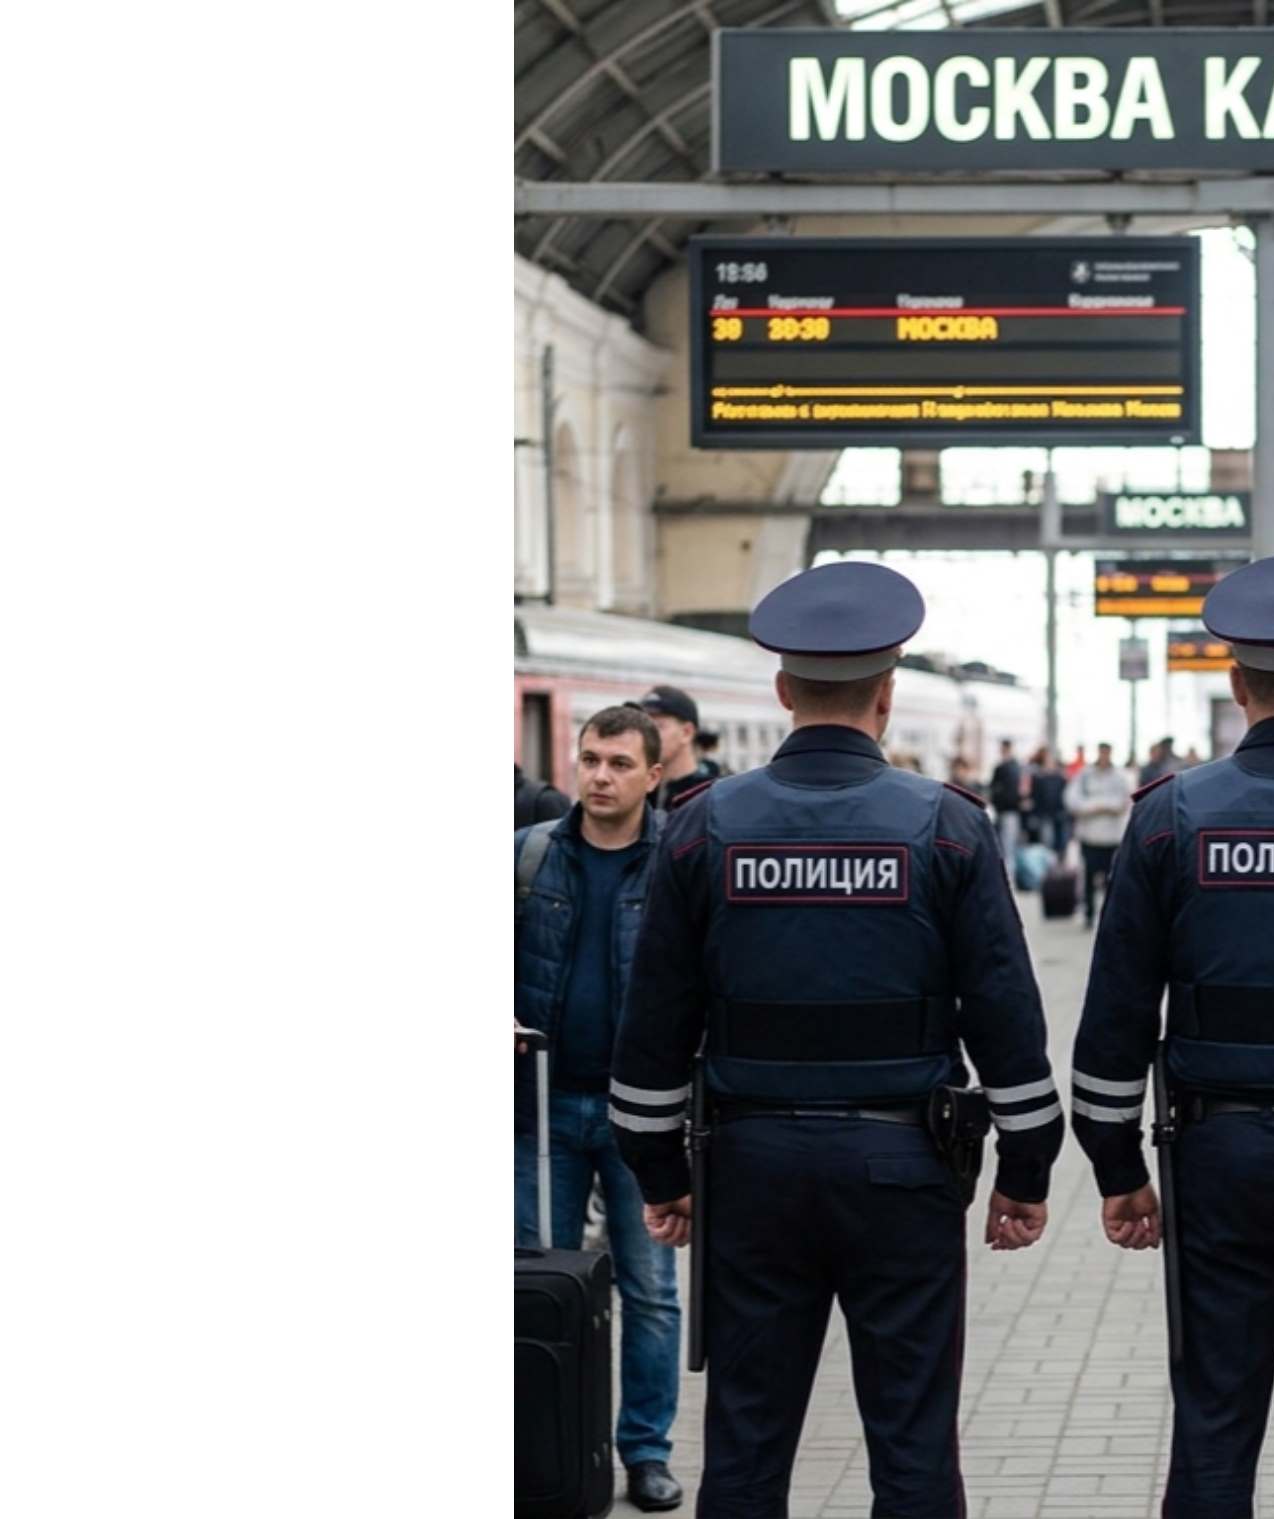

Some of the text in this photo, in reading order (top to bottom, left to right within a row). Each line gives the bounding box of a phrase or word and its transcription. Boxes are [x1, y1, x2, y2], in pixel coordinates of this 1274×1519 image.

[788, 55, 1175, 142] МОСКВА
[897, 317, 998, 341] МОСКВА
[1115, 495, 1246, 529] МОСКВА
[735, 857, 898, 895] ПОЛИЦИЯ
